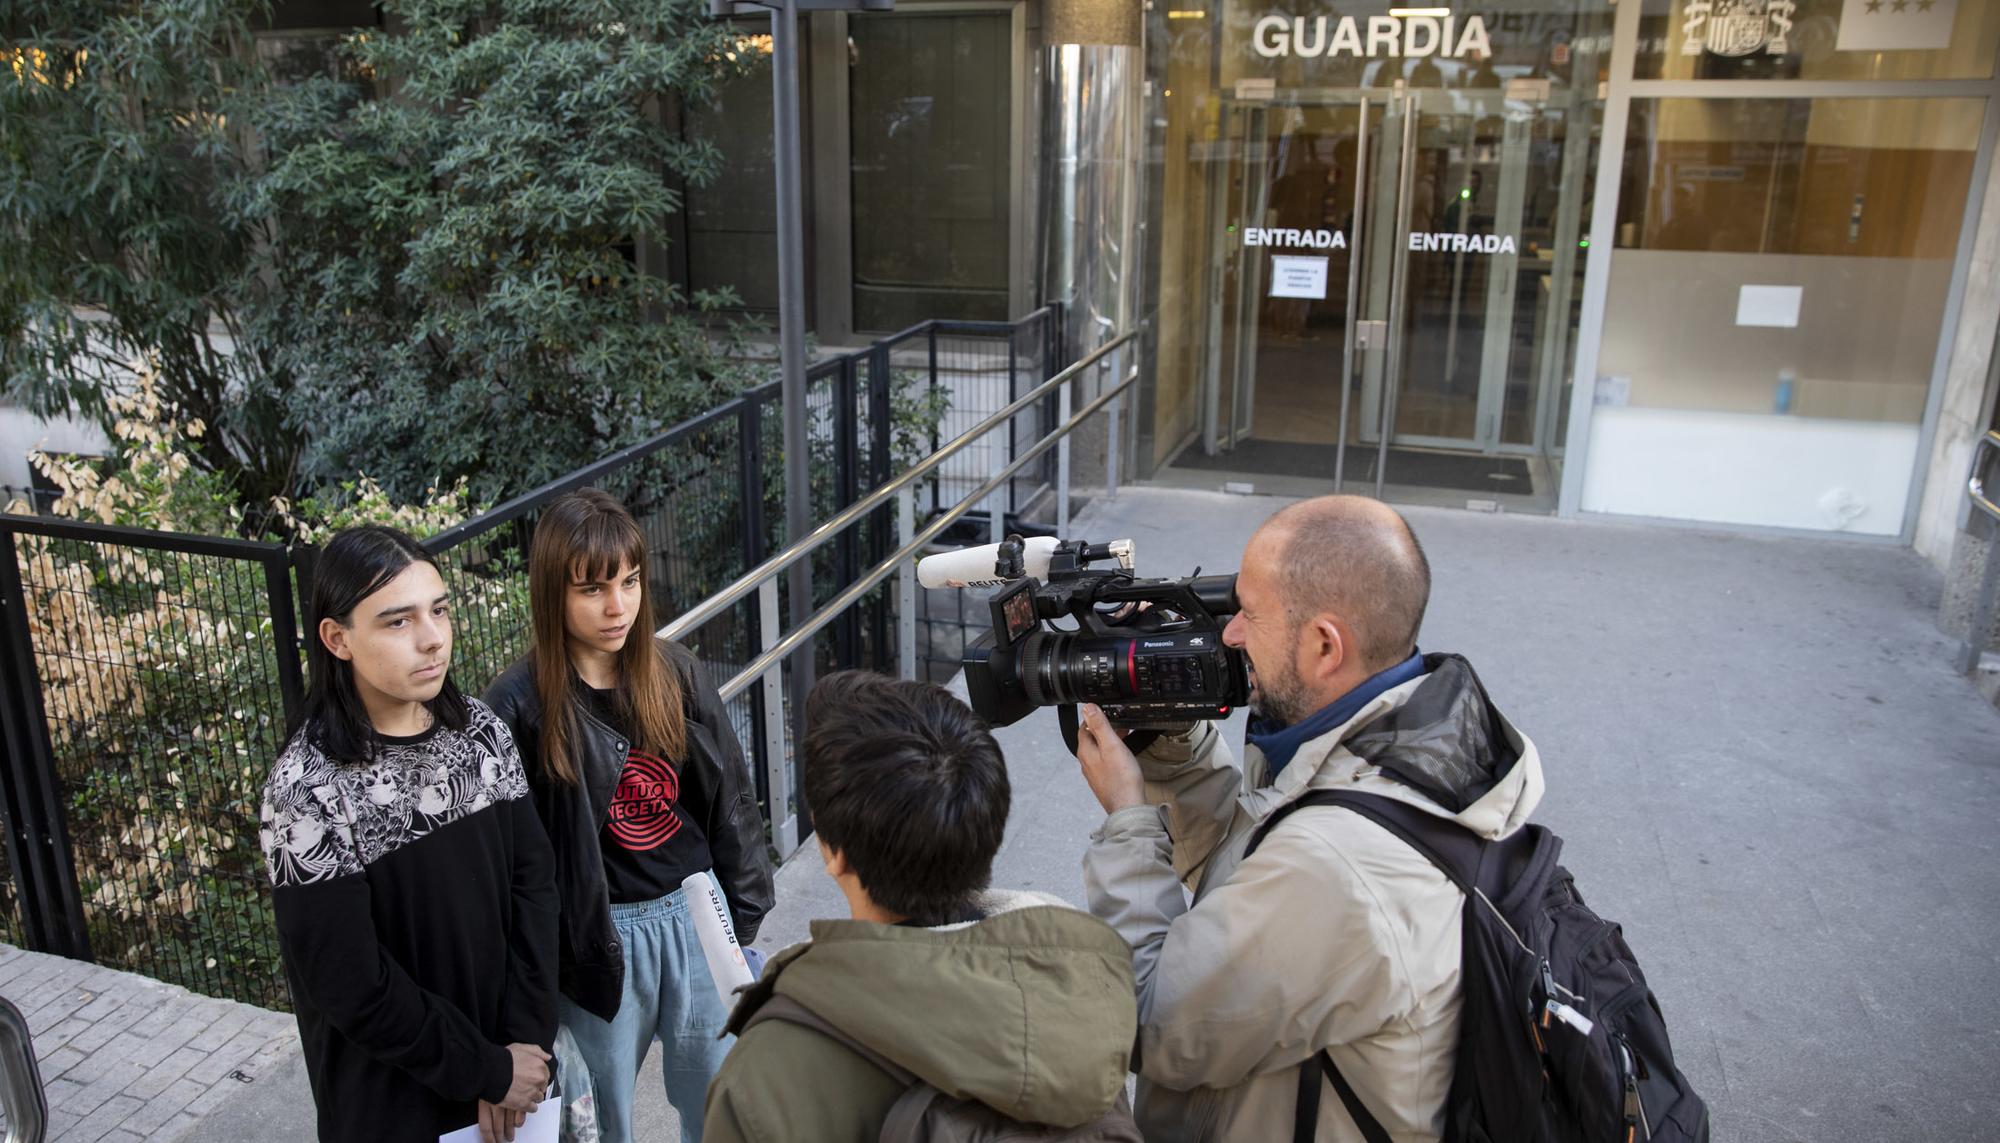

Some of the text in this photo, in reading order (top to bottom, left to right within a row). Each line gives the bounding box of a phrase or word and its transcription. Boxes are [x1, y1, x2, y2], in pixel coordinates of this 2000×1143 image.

[1253, 15, 1492, 58] GUARDIA
[1244, 227, 1346, 249] ENTRADA
[1408, 231, 1516, 254] ENTRADA
[1144, 640, 1174, 648] Panasonic
[708, 889, 736, 945] REUTERS
